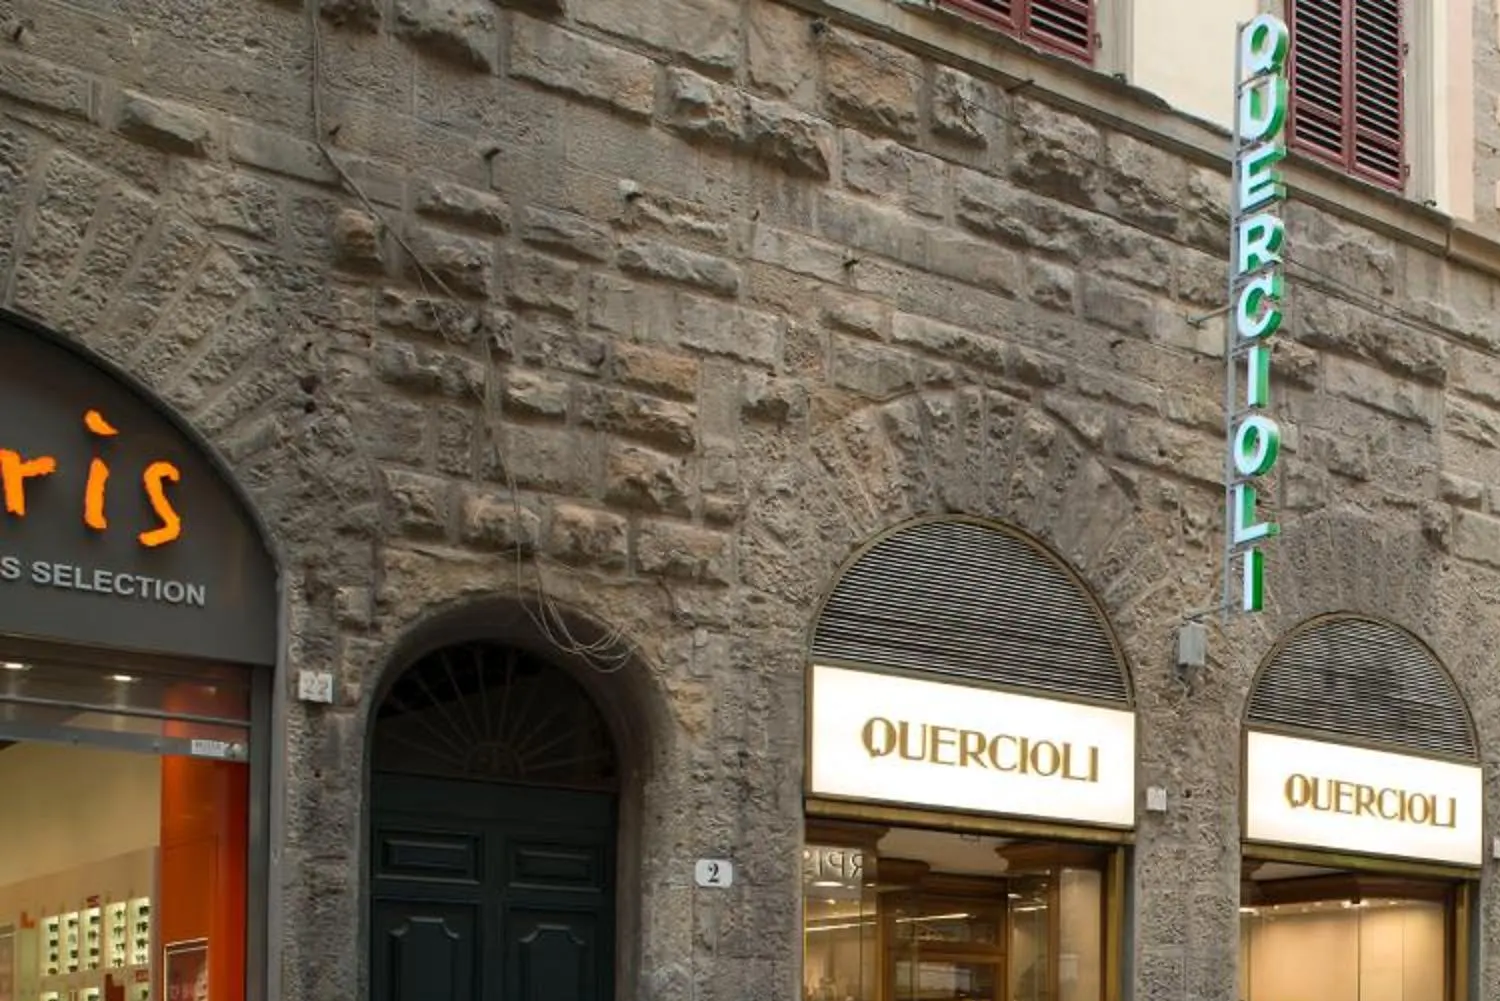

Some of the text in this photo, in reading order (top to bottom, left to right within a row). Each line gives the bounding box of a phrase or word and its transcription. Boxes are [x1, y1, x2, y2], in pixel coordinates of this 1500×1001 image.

[1233, 13, 1289, 612] QUERCIOLI
[31, 560, 206, 605] SELECTION
[861, 716, 1100, 783] QUERCIOLI
[1284, 773, 1457, 829] QUERCIOLI
[707, 863, 720, 883] 2
